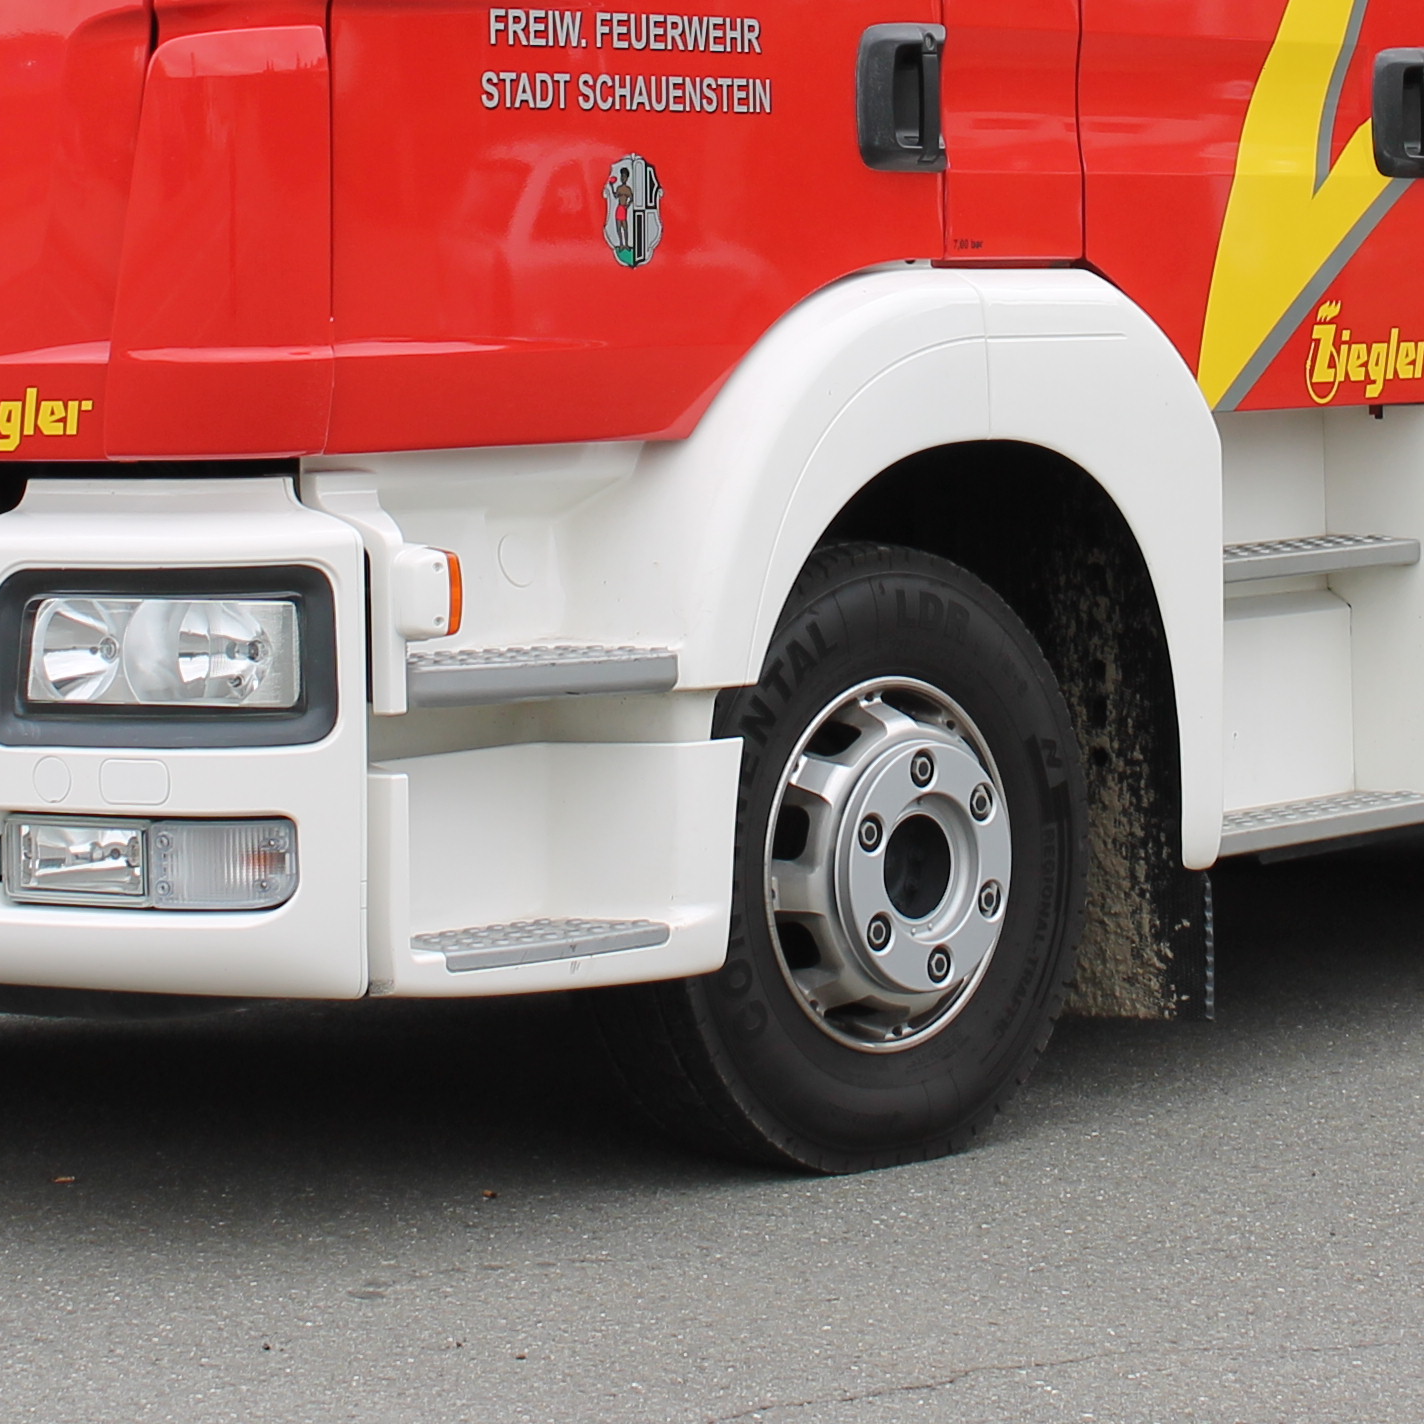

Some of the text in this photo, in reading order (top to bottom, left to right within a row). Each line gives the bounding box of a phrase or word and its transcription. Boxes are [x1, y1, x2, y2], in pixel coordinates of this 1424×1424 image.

[489, 8, 762, 55] FREIW. FEUERWEHR
[481, 72, 772, 115] STADT SCHAUENSTEIN
